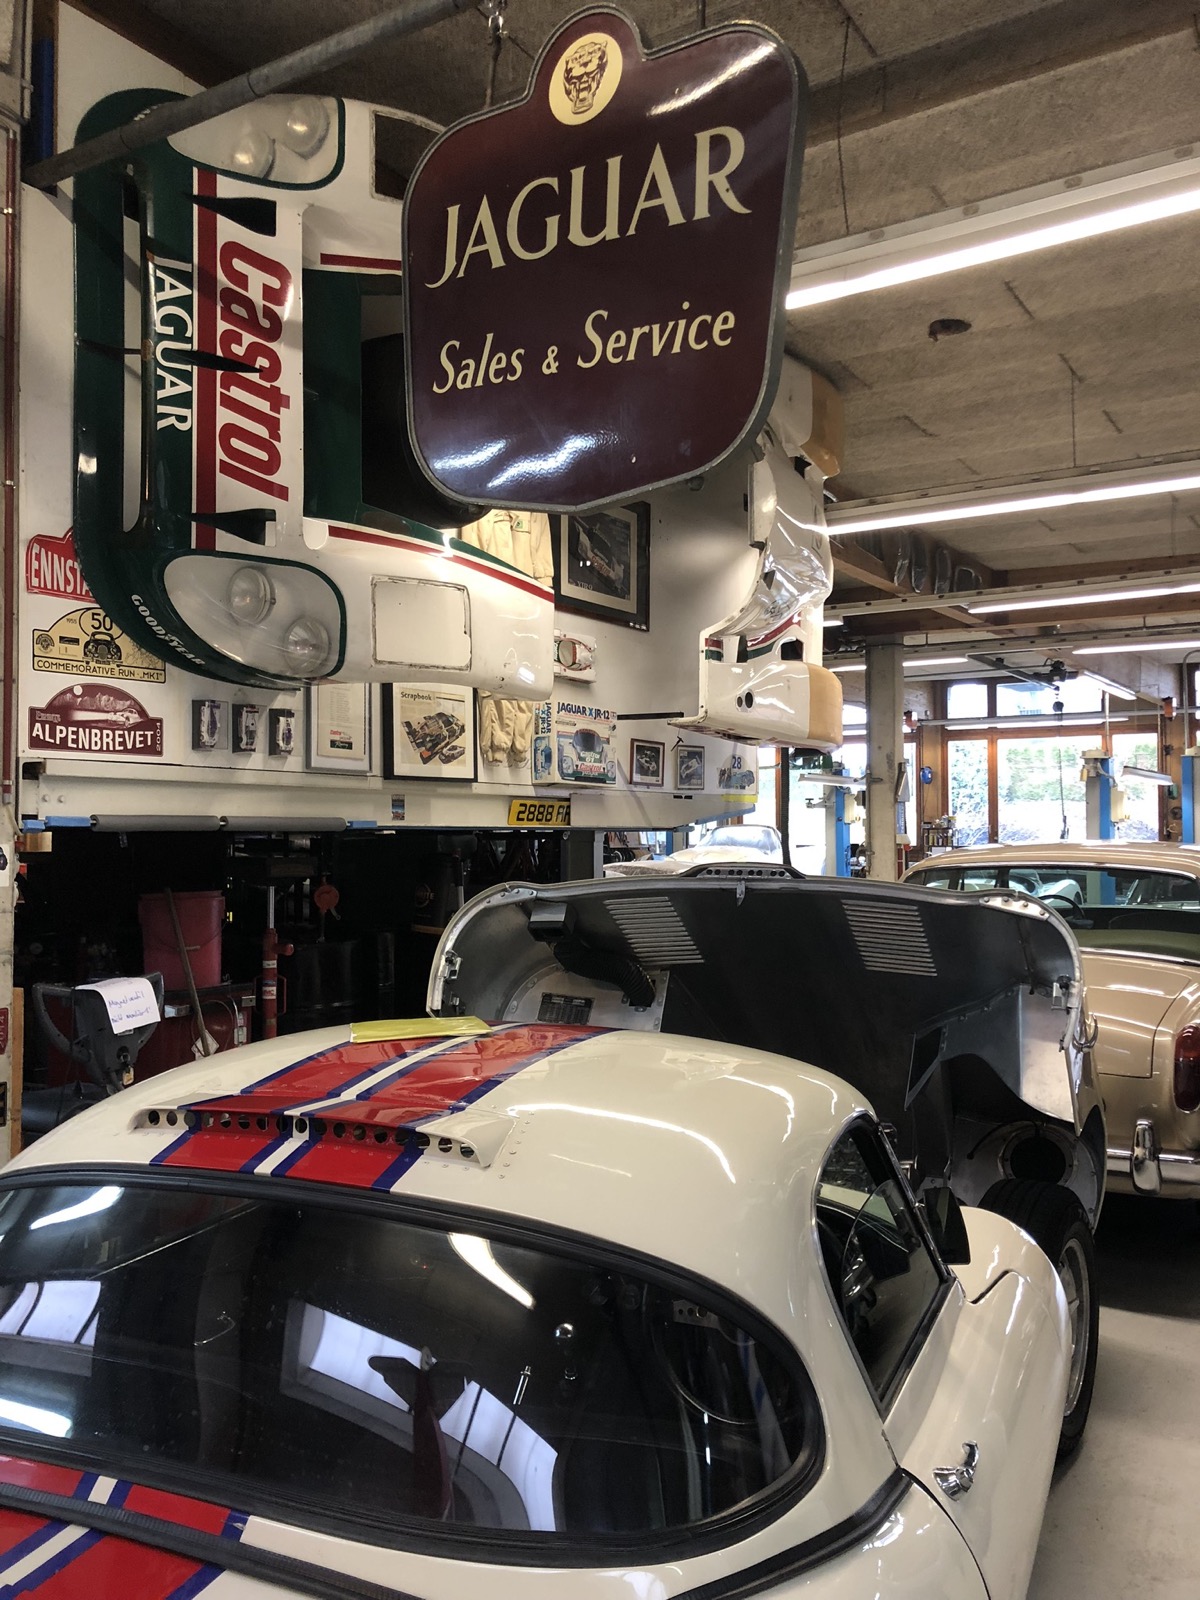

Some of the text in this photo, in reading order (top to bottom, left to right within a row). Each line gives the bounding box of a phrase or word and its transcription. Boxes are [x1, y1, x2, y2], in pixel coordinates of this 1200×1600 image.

[424, 125, 752, 289] JAGUAR
[153, 255, 193, 431] JAGUAR
[432, 300, 736, 394] Sales & Service
[218, 240, 294, 502] Castrol
[91, 612, 113, 631] 50
[36, 660, 116, 676] COMMEMORATIVE
[118, 668, 135, 678] RUN
[400, 690, 433, 702] Scrapbook
[557, 702, 587, 716] JAGUAR
[32, 722, 154, 751] ALPENBREVET
[732, 756, 742, 770] 28
[516, 803, 555, 822] 2888
